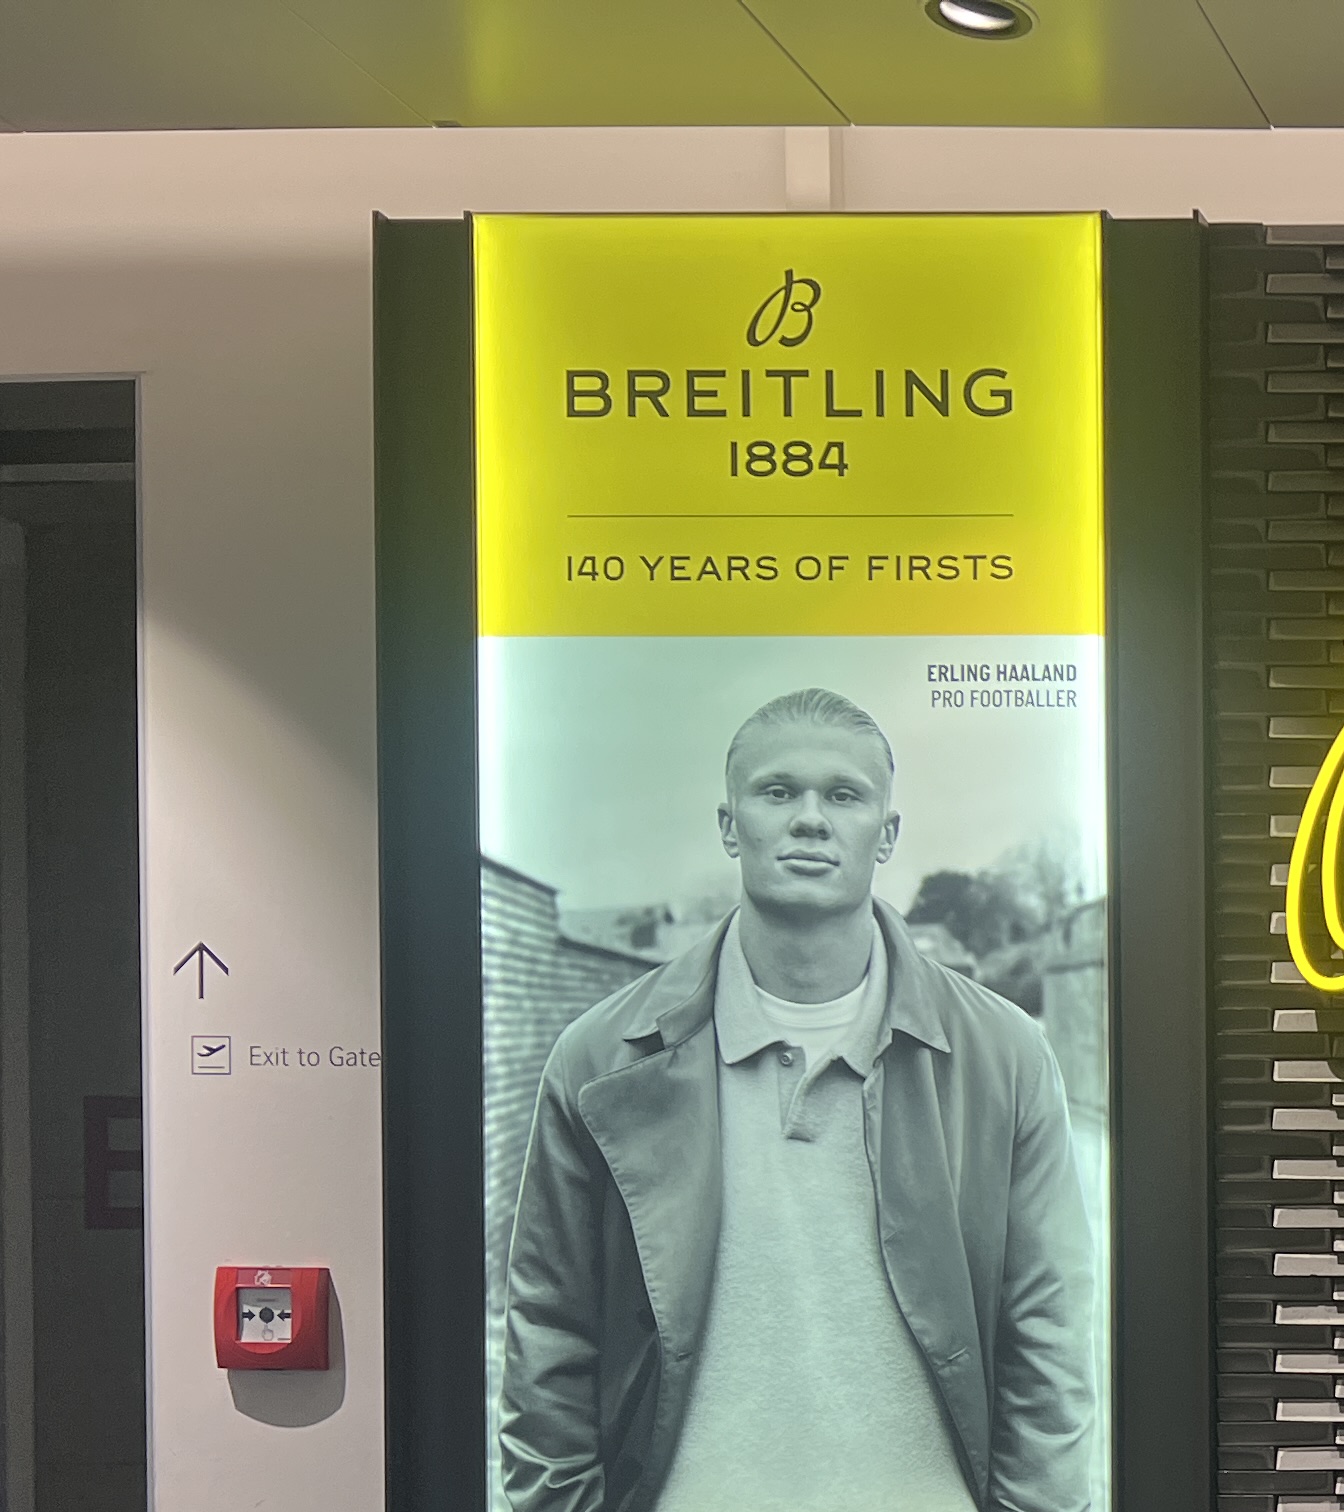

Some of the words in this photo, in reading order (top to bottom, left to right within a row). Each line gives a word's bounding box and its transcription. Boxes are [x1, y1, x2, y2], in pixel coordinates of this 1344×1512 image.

[565, 367, 1013, 418] BREITLING
[730, 441, 848, 477] 1884
[567, 555, 625, 582] 140
[639, 555, 779, 582] YEARS
[794, 555, 849, 582] OF
[868, 554, 1014, 581] FIRSTS
[927, 665, 990, 683] ERLING
[996, 664, 1077, 682] HAALAND
[931, 690, 965, 708] PRO
[969, 689, 1077, 708] FOOTBALLER
[250, 1046, 289, 1066] Exit
[298, 1048, 320, 1067] to
[329, 1046, 382, 1067] Gate
